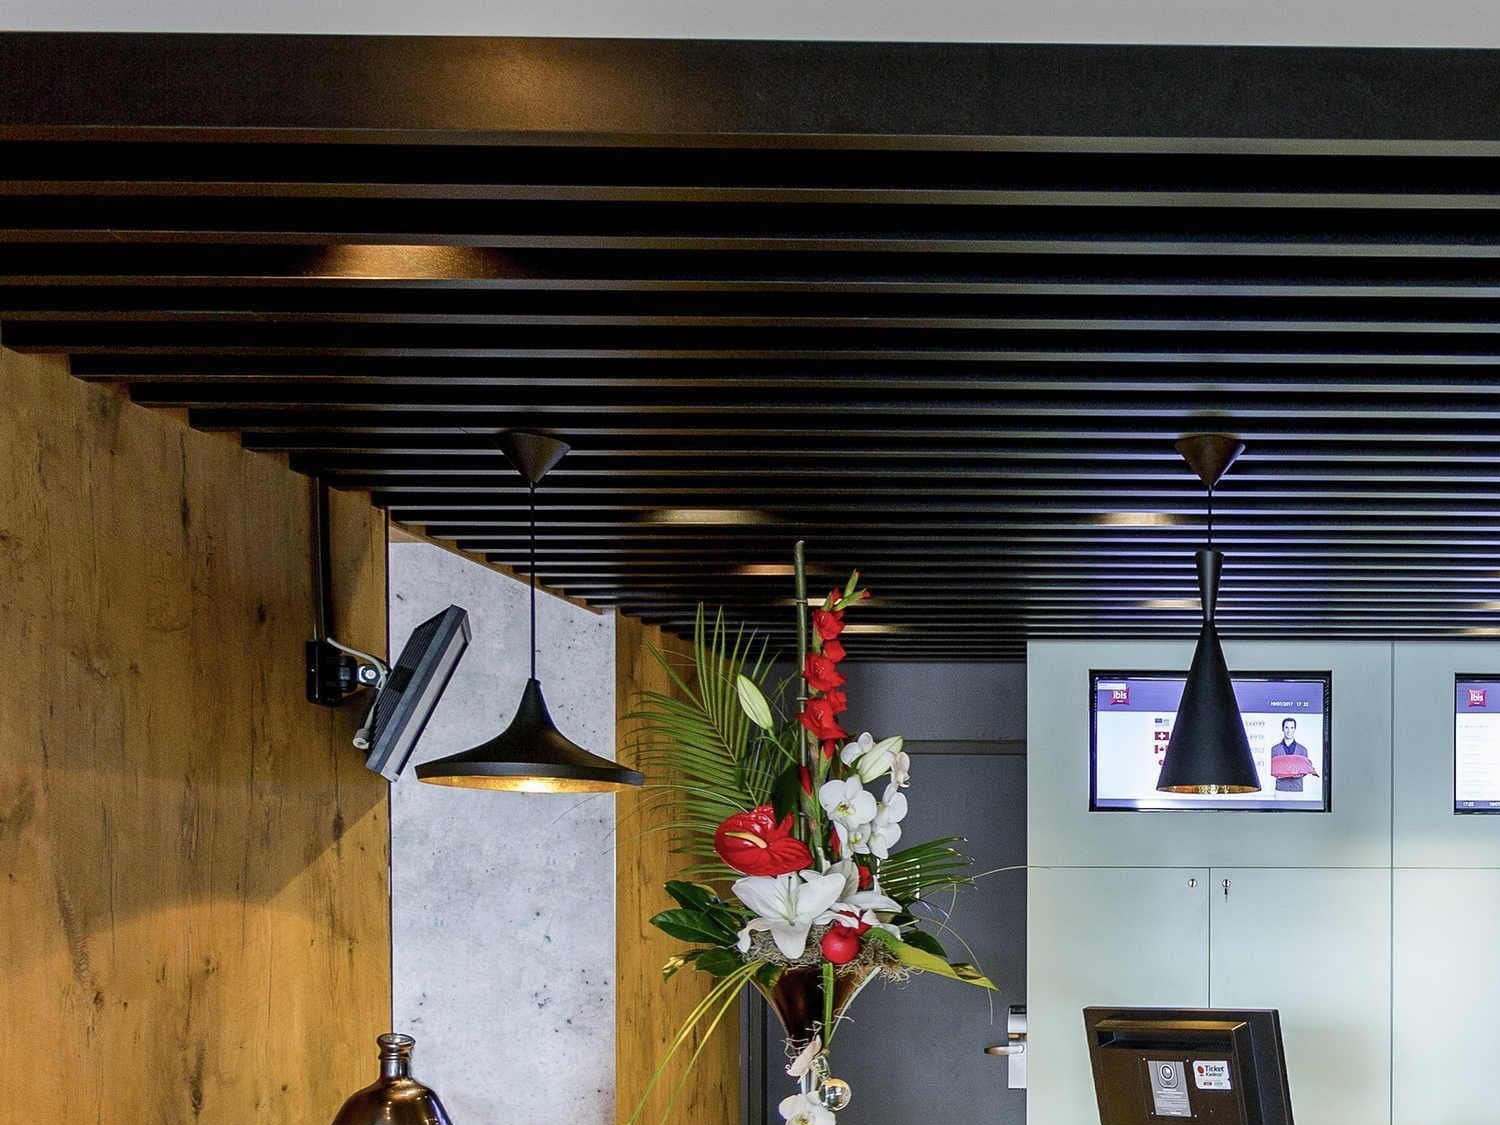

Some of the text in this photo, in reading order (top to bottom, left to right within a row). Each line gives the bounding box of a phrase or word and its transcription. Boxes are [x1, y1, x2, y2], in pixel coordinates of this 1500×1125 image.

[1112, 690, 1127, 699] ibis
[1470, 693, 1484, 702] ibis
[1205, 1065, 1225, 1073] Ticket
